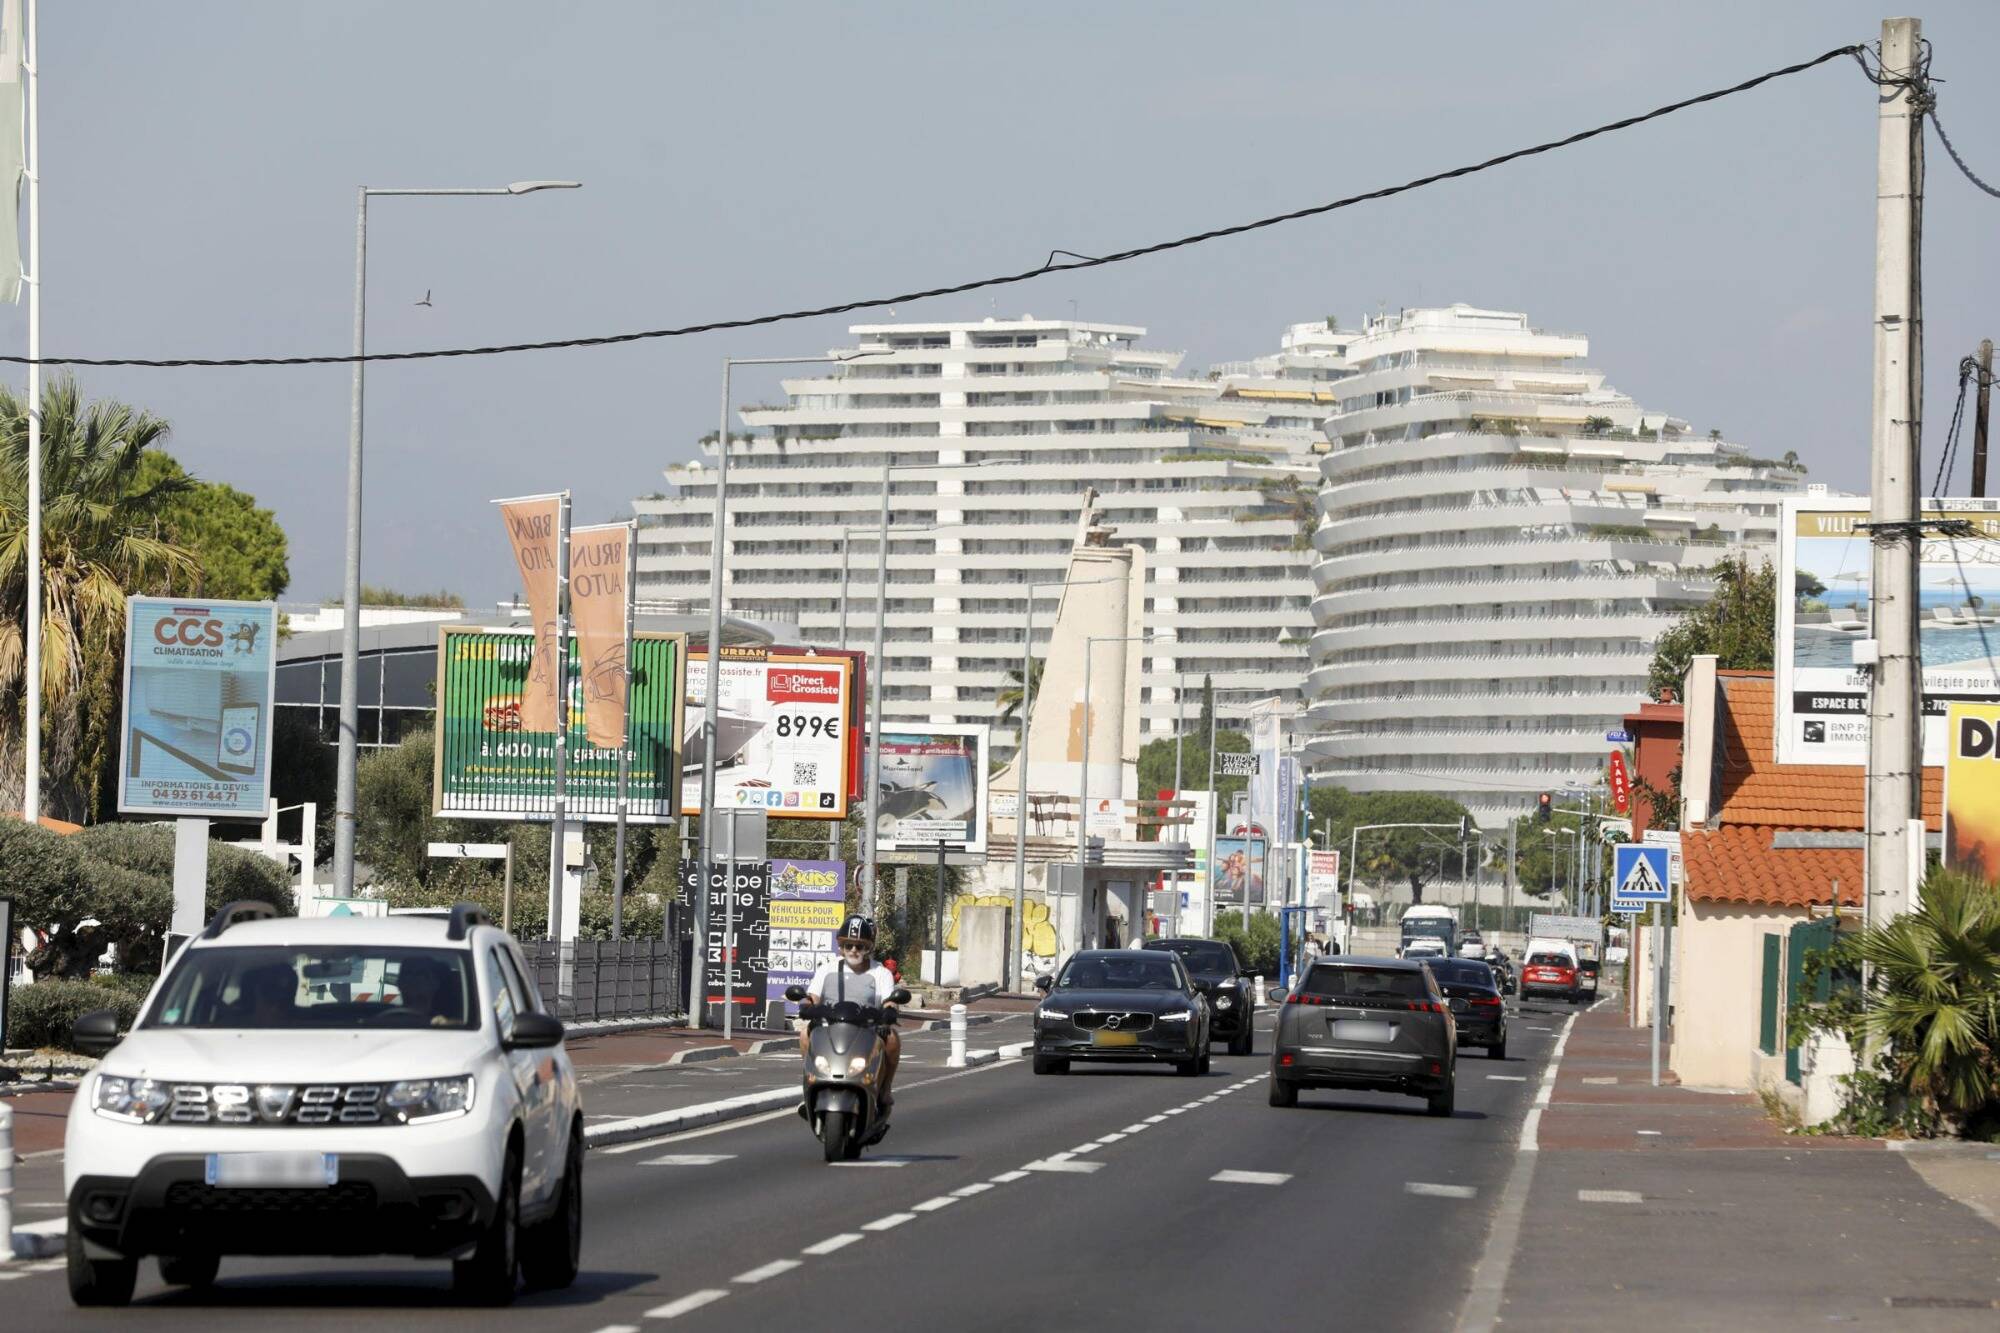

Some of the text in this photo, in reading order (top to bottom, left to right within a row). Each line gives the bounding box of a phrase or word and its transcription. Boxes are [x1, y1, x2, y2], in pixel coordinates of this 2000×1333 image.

[154, 617, 224, 648] CCS
[154, 646, 224, 658] CLIMATISATION
[720, 648, 766, 656] URBAN
[791, 675, 824, 686] Direct
[1967, 679, 1990, 689] pour
[792, 685, 839, 695] Grossiste
[1812, 698, 1845, 710] ESPACE
[1848, 699, 1860, 710] DE
[776, 714, 840, 739] 899€
[1831, 724, 1854, 732] BNP
[496, 742, 531, 758] 600
[1223, 753, 1258, 762] STUDIO
[141, 780, 212, 791] INFORMATIONS
[223, 783, 250, 792] DEVIS
[1613, 759, 1626, 804] TABAC
[152, 788, 238, 802] 04 93 61 44 71
[688, 873, 762, 891] ecape
[796, 871, 839, 887] KIDS
[710, 892, 754, 907] ame
[813, 906, 833, 915] POUR
[771, 915, 800, 924] NFANTS
[807, 916, 840, 926] ADULTES
